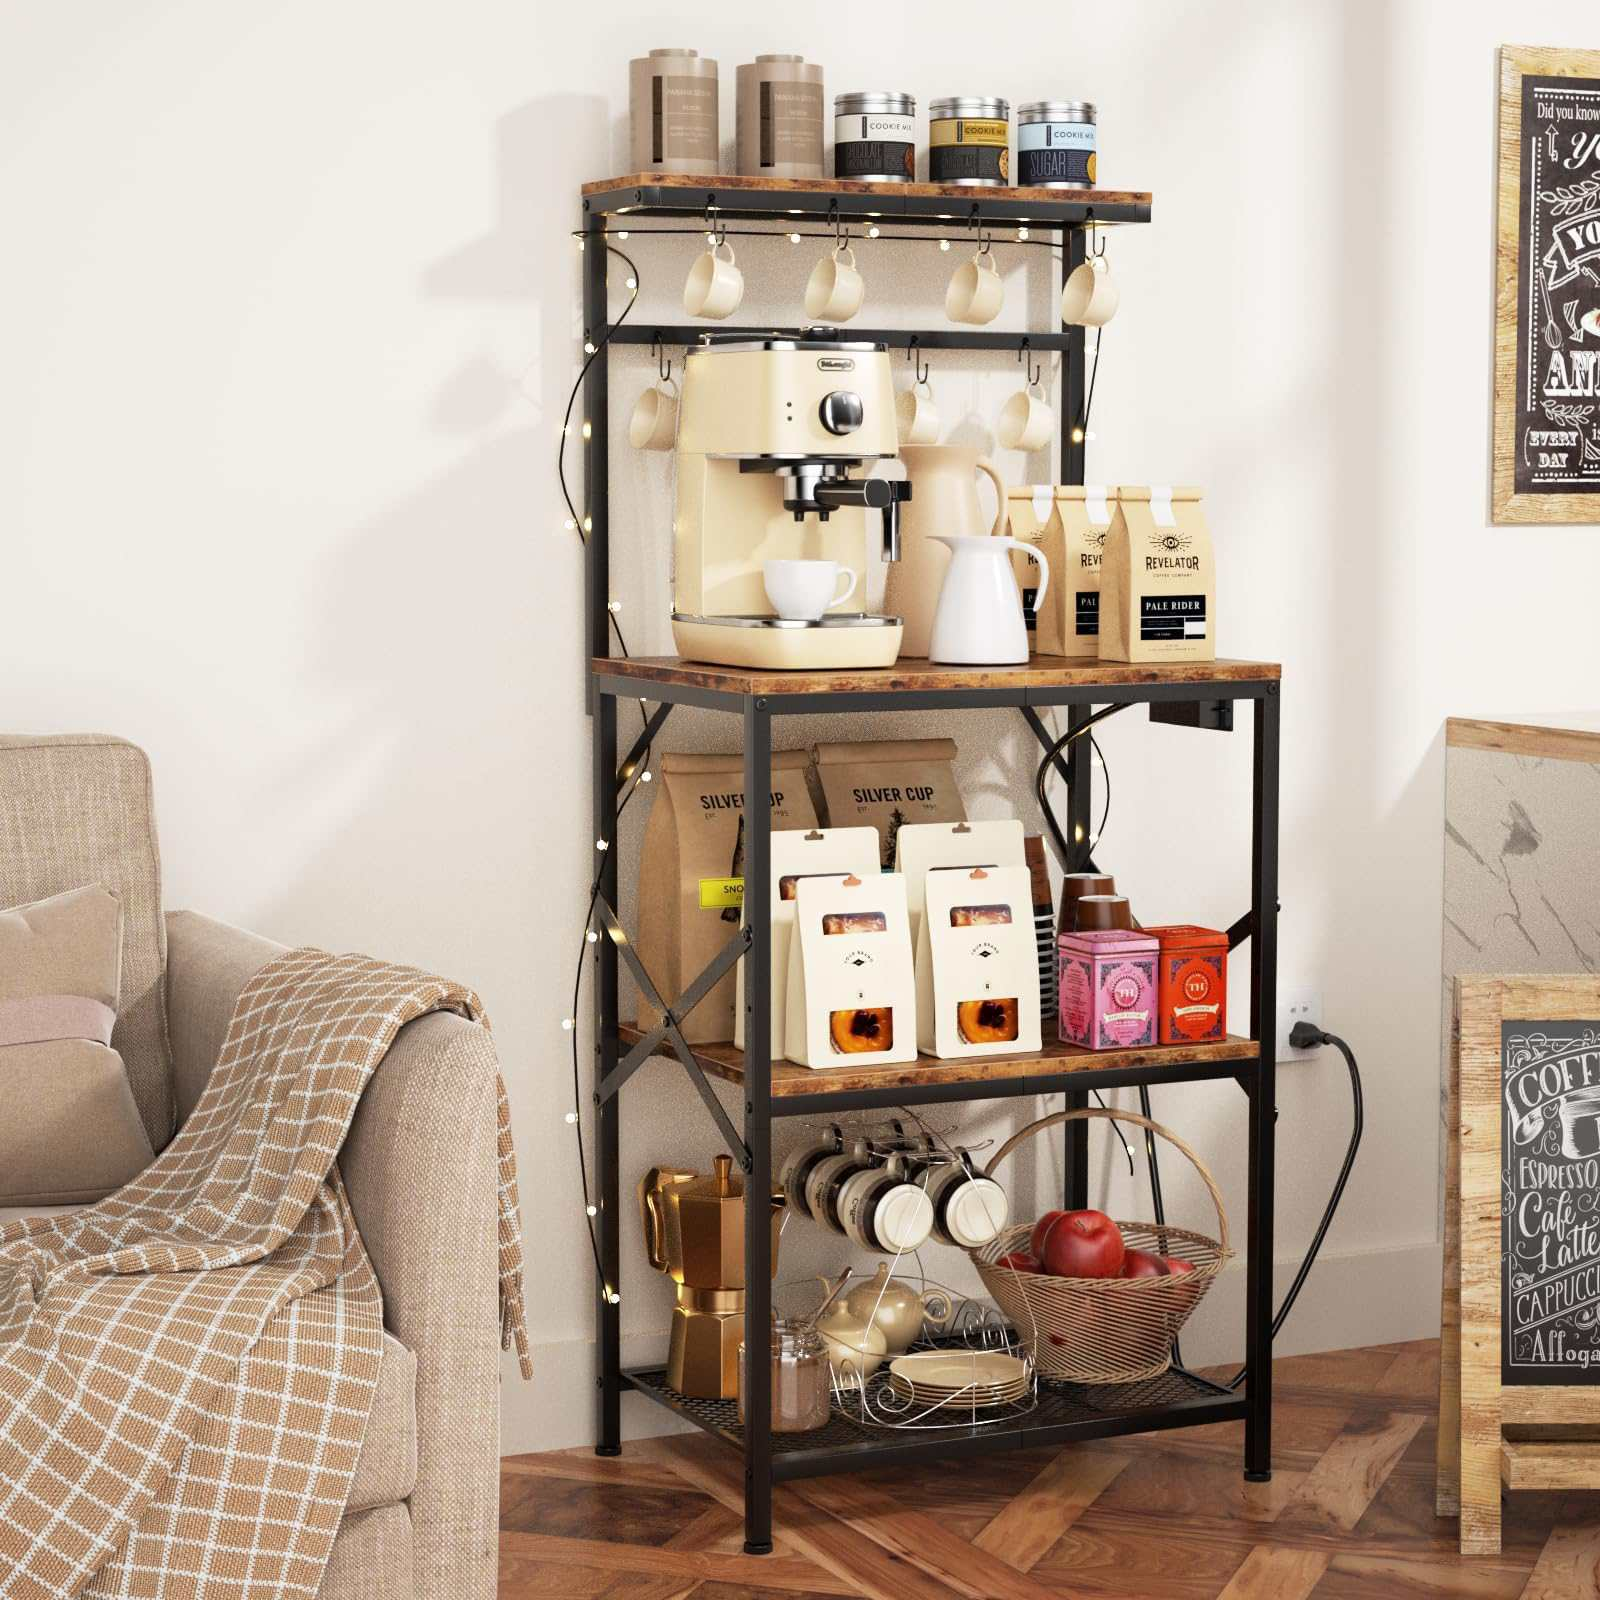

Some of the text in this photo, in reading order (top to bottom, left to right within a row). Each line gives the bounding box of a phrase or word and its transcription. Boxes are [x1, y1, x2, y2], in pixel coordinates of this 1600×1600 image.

[1537, 102, 1554, 119] Did
[1556, 107, 1574, 123] you
[869, 122, 901, 130] COOKIE
[964, 127, 996, 135] COOKIE
[1054, 131, 1083, 139] COOKIE
[1563, 131, 1600, 170] Y
[1030, 151, 1066, 177] SUGAR
[1543, 350, 1600, 397] AN
[1529, 431, 1579, 447] EVERY
[1538, 453, 1569, 468] DAY
[1145, 556, 1200, 571] REVELATOR
[1146, 601, 1201, 611] PALE RIDER
[700, 793, 744, 810] SILVE
[853, 786, 934, 803] SILVER CUP
[1518, 1052, 1600, 1108] COFF
[1519, 1157, 1599, 1190] ESPRESSO
[1516, 1216, 1600, 1274] Latte
